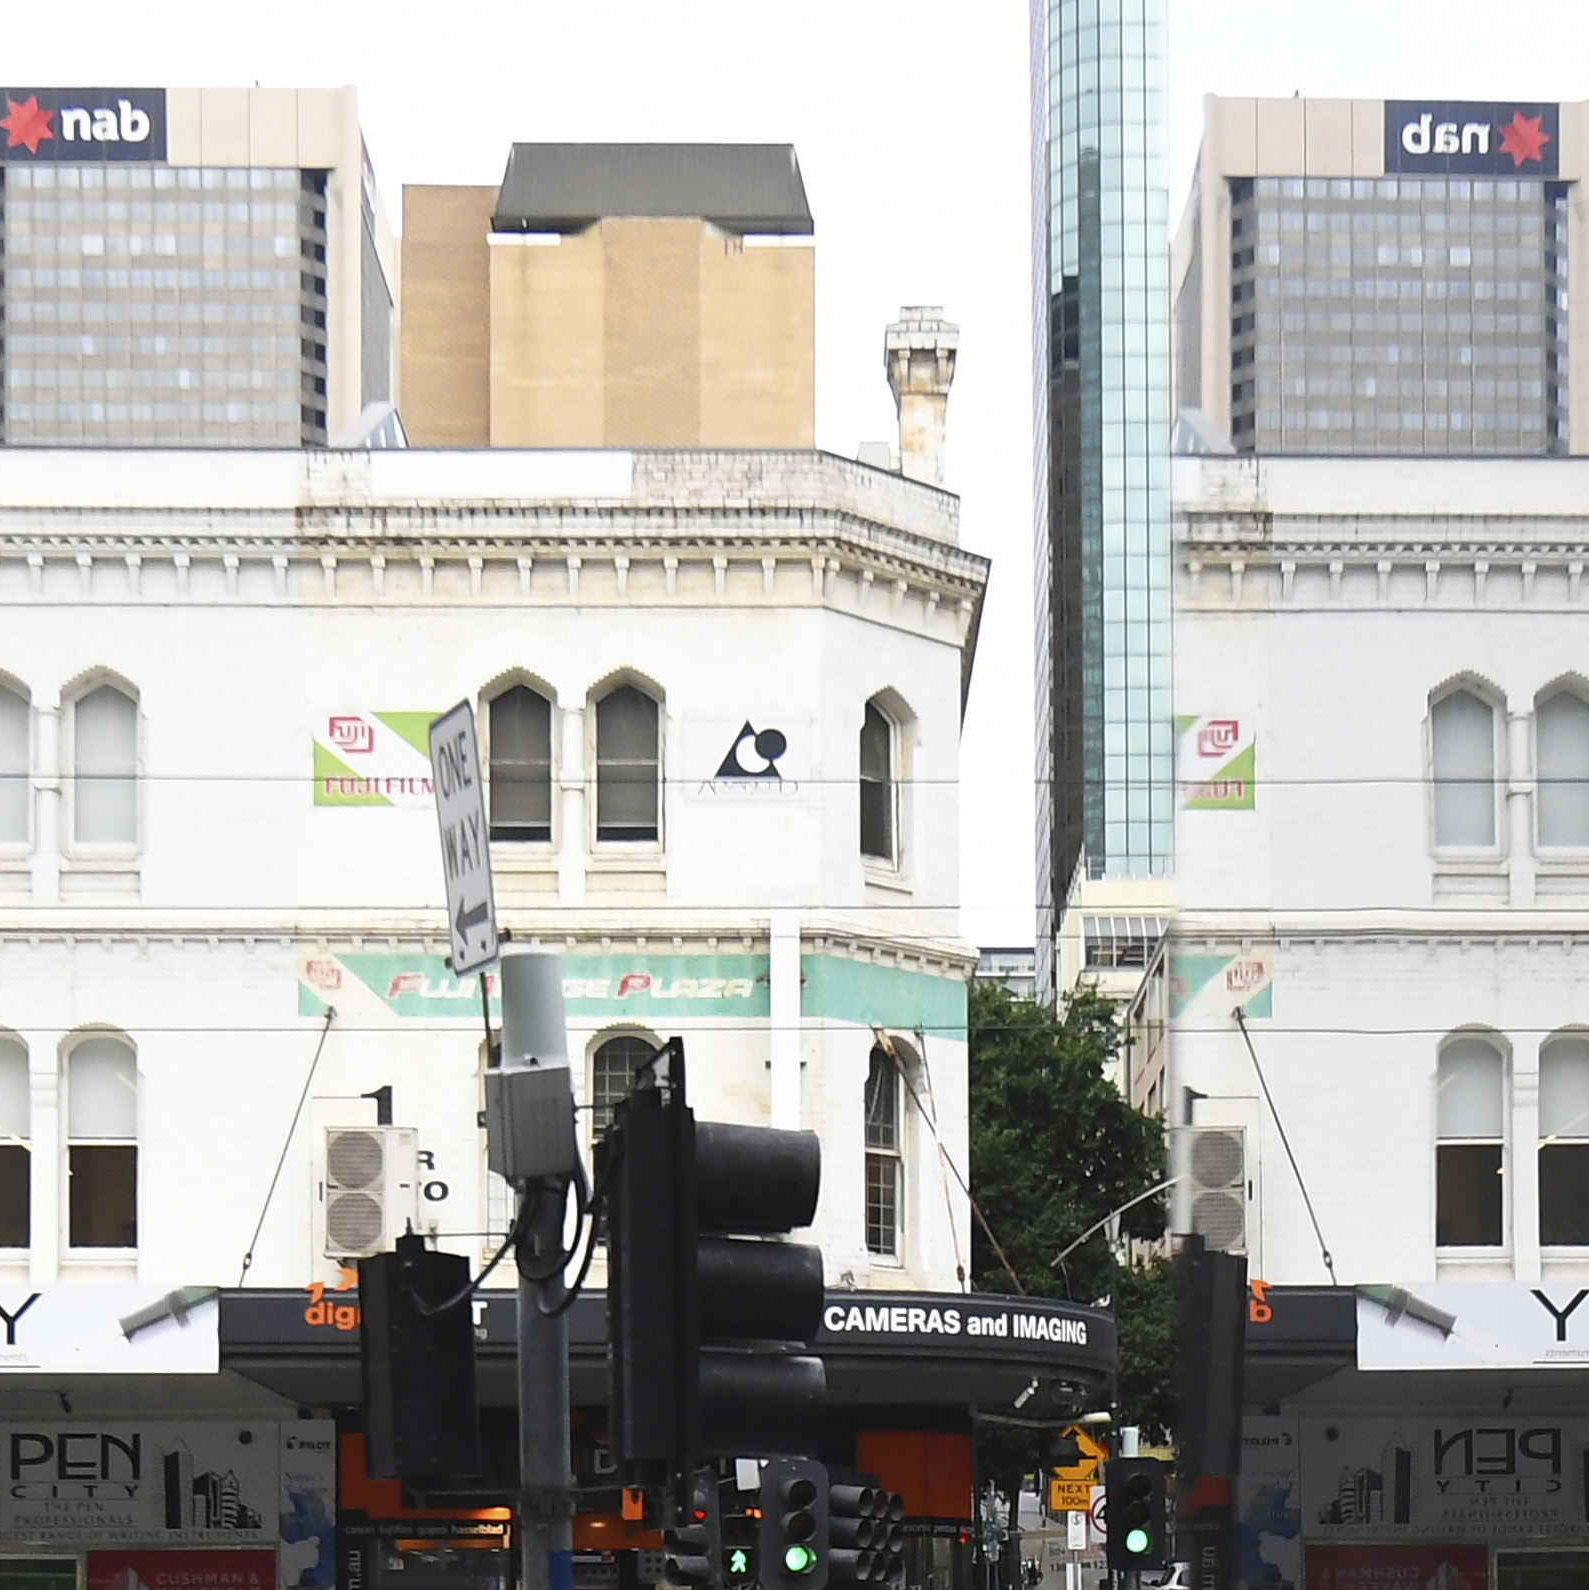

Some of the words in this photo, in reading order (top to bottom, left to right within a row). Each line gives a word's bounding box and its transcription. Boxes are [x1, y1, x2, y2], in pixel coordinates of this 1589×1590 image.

[61, 98, 150, 142] nab
[437, 732, 473, 801] ONE
[443, 808, 481, 881] WAY
[615, 974, 754, 999] PLAZA
[823, 1306, 961, 1334] CAMERAS
[967, 1314, 1007, 1337] and
[1012, 1314, 1088, 1345] IMAGING
[10, 1433, 140, 1480] PEN
[10, 1485, 140, 1498] CITY
[1057, 1484, 1090, 1494] NEXT
[1061, 1496, 1088, 1506] 100m
[13, 1515, 134, 1526] PROFESSIONALS
[155, 1572, 244, 1586] CUSHMAN
